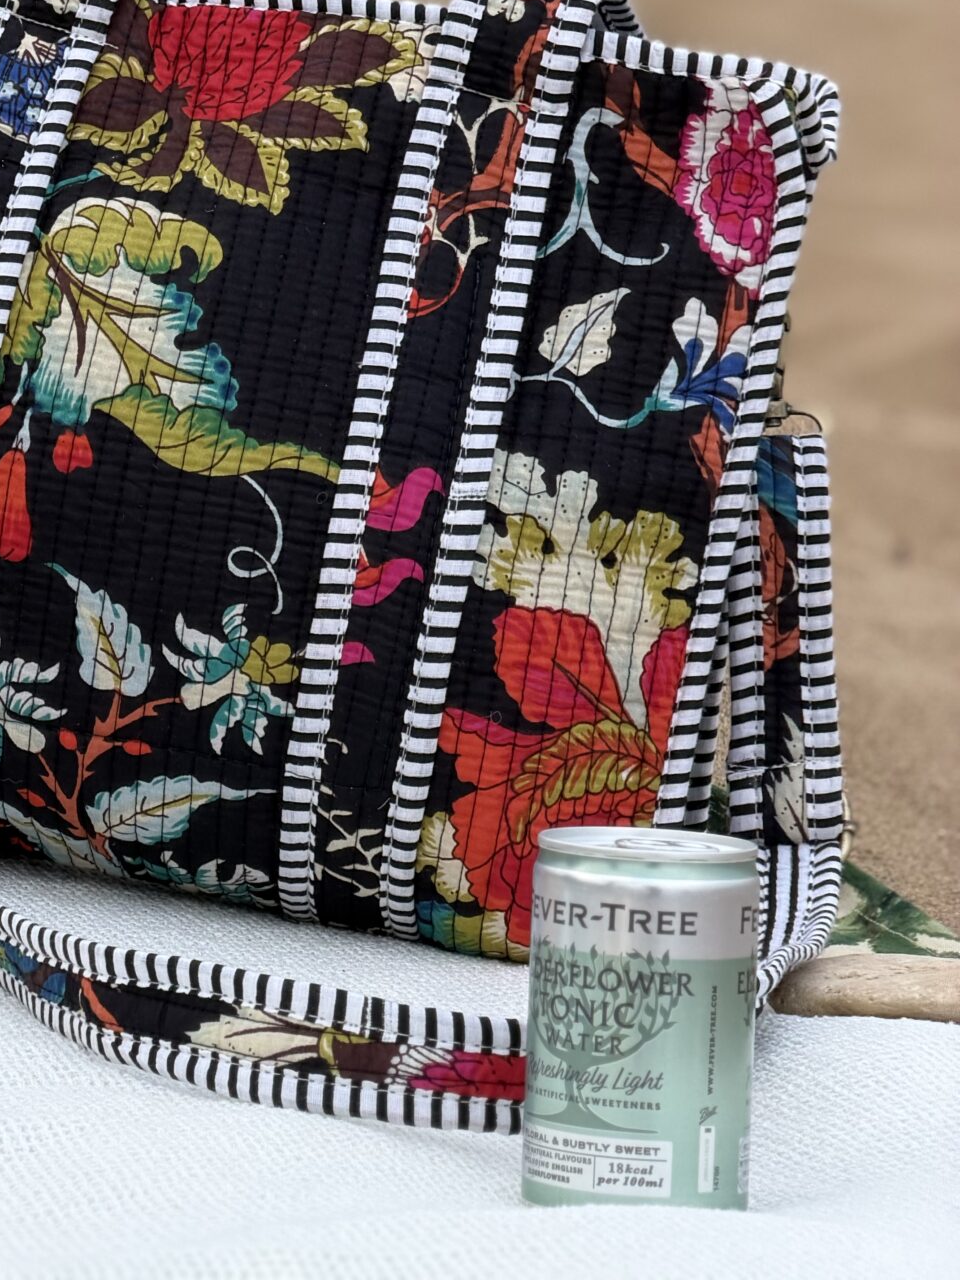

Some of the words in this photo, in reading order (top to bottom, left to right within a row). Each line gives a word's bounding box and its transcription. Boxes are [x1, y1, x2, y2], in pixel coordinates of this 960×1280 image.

[533, 895, 698, 936] EVER-TREE
[534, 957, 695, 996] DERFLOWER
[539, 991, 635, 1029] TONIC
[544, 1023, 624, 1057] WATER
[612, 1067, 664, 1096] Light
[585, 1096, 662, 1111] SWEETENERS
[554, 1152, 592, 1165] FLAVOURS
[562, 1138, 611, 1154] SUBTLY
[614, 1145, 661, 1157] SWEET
[608, 1162, 654, 1176] 18kcal
[596, 1176, 620, 1187] per
[622, 1176, 664, 1189] 100ml
